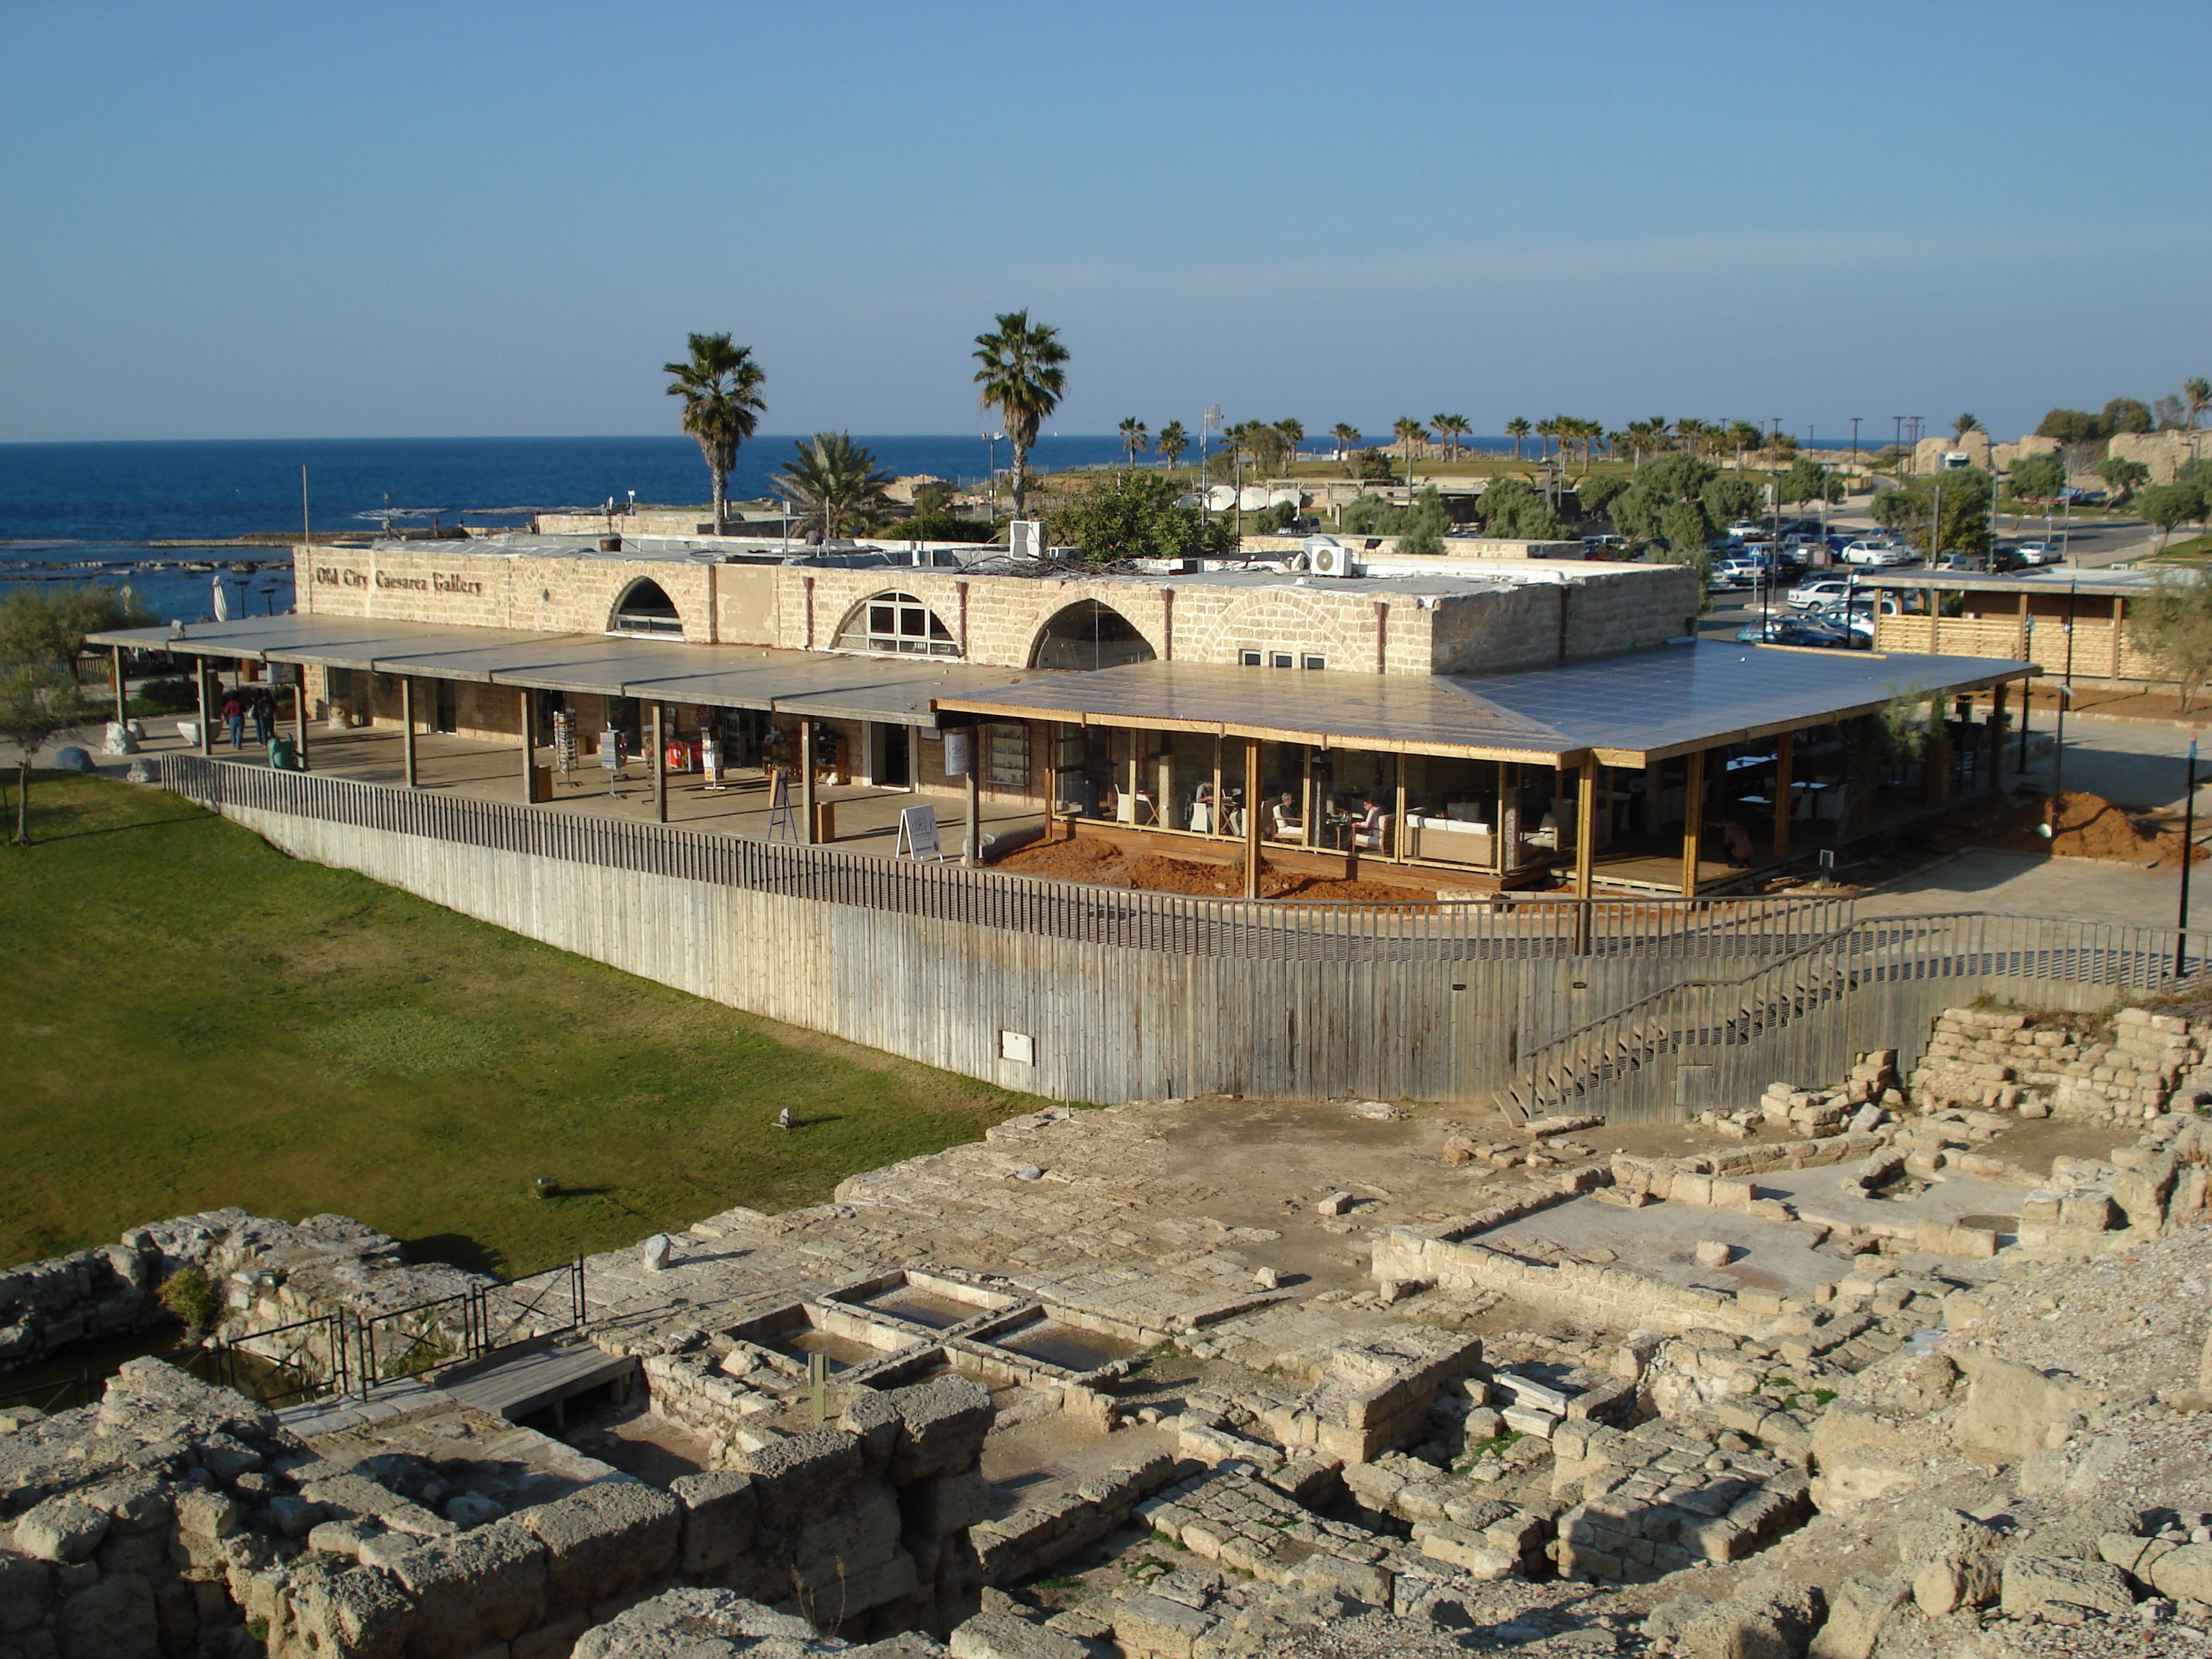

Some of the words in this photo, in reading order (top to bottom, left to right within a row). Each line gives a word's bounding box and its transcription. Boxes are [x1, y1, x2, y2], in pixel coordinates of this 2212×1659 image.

[316, 567, 339, 585] Old
[343, 568, 369, 590] City
[375, 570, 429, 591] Caesarea
[432, 571, 483, 596] Gallery
